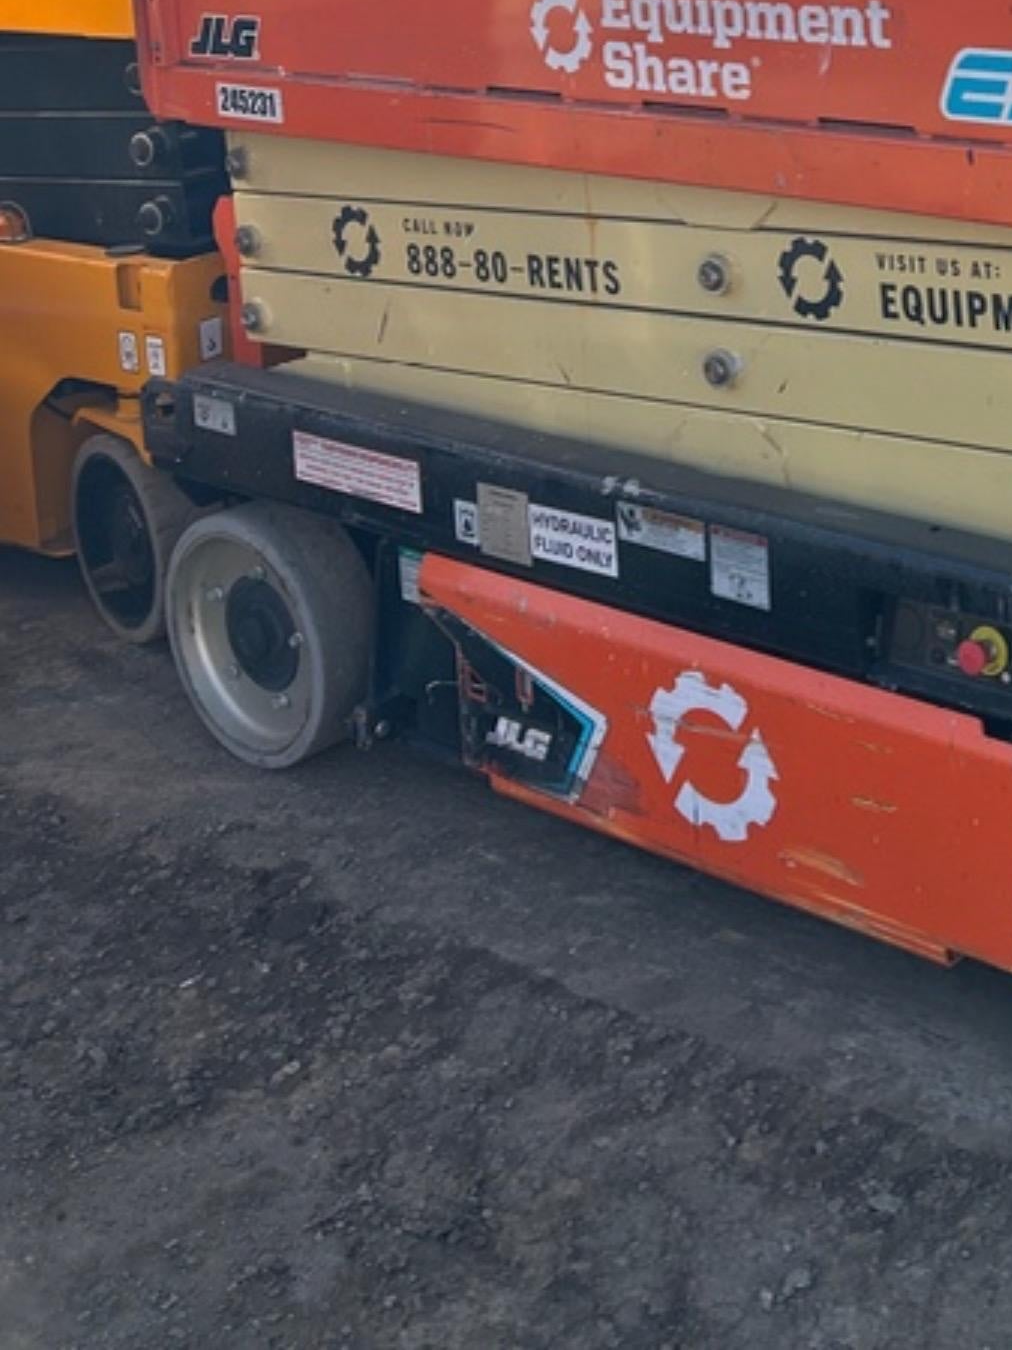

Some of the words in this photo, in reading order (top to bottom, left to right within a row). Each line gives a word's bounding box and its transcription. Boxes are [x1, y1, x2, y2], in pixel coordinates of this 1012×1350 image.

[190, 15, 260, 59] JLG
[219, 86, 277, 117] 245231
[402, 218, 438, 234] CALL
[443, 221, 475, 237] NOW
[406, 243, 620, 295] 888-80-RENTS
[876, 253, 926, 274] VISIT
[936, 258, 961, 277] US
[971, 261, 1001, 279] AT:
[532, 510, 613, 544] HYDRAULIC
[533, 534, 573, 559] FLUID
[575, 545, 613, 568] ONLY
[485, 717, 552, 761] JLG
